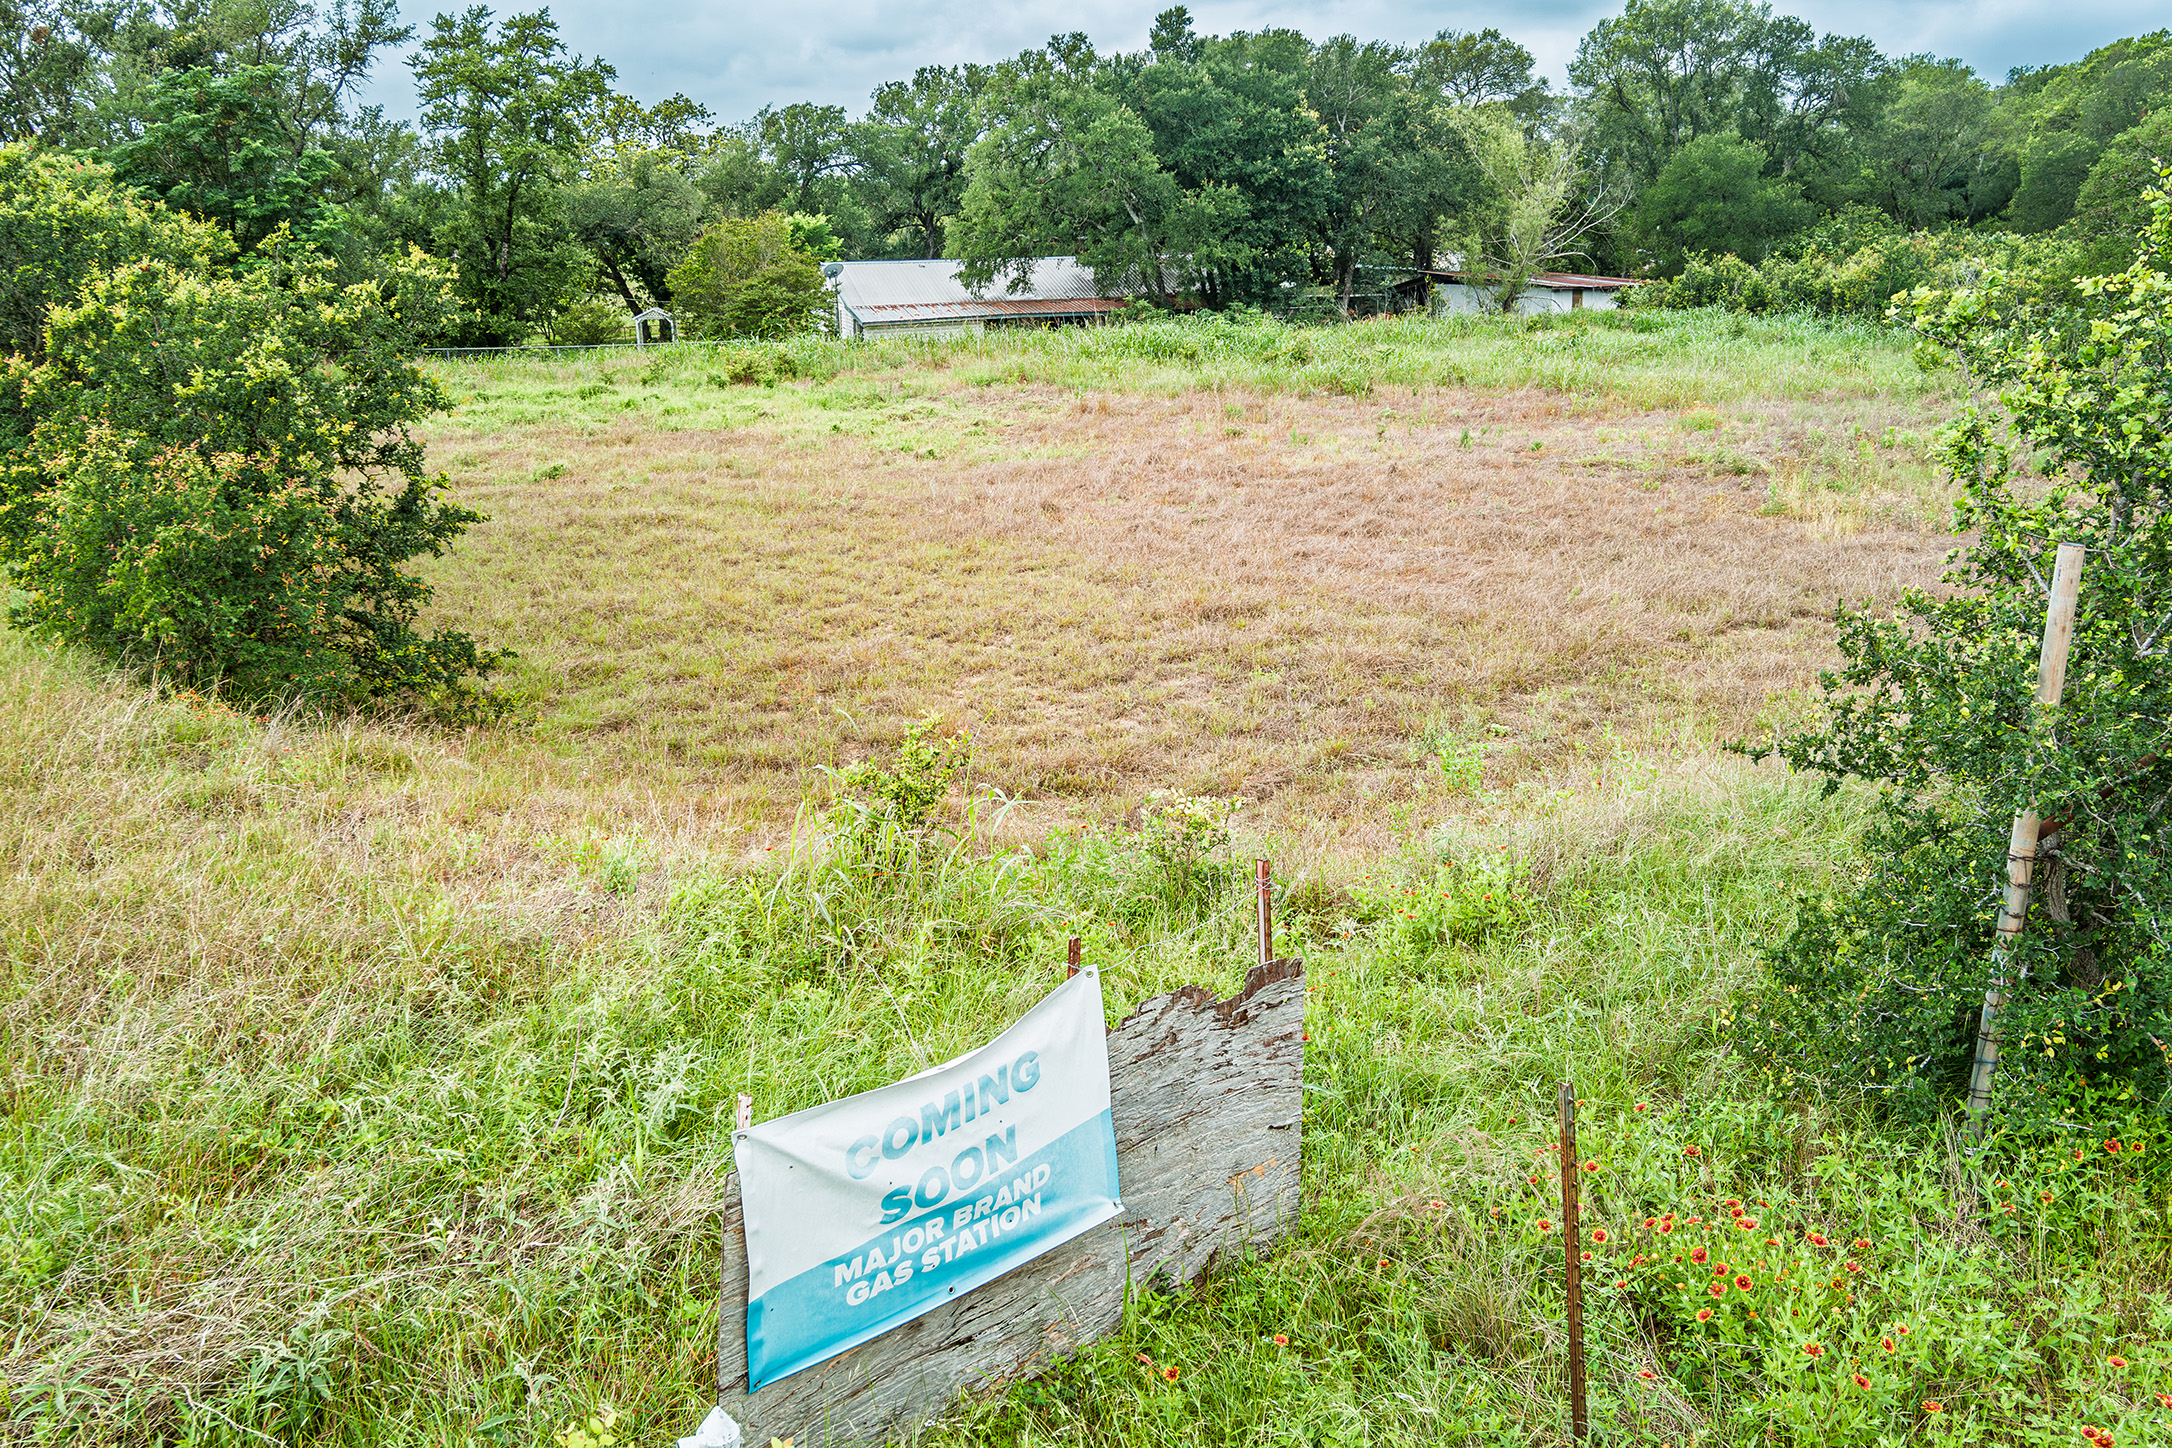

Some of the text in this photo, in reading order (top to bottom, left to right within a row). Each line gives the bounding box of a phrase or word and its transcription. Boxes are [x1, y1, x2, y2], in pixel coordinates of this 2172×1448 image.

[846, 1051, 1041, 1180] COMING
[879, 1124, 1018, 1225] SOON
[833, 1164, 1051, 1288] MAJOR BRAND
[846, 1192, 1042, 1306] GAS STATION
